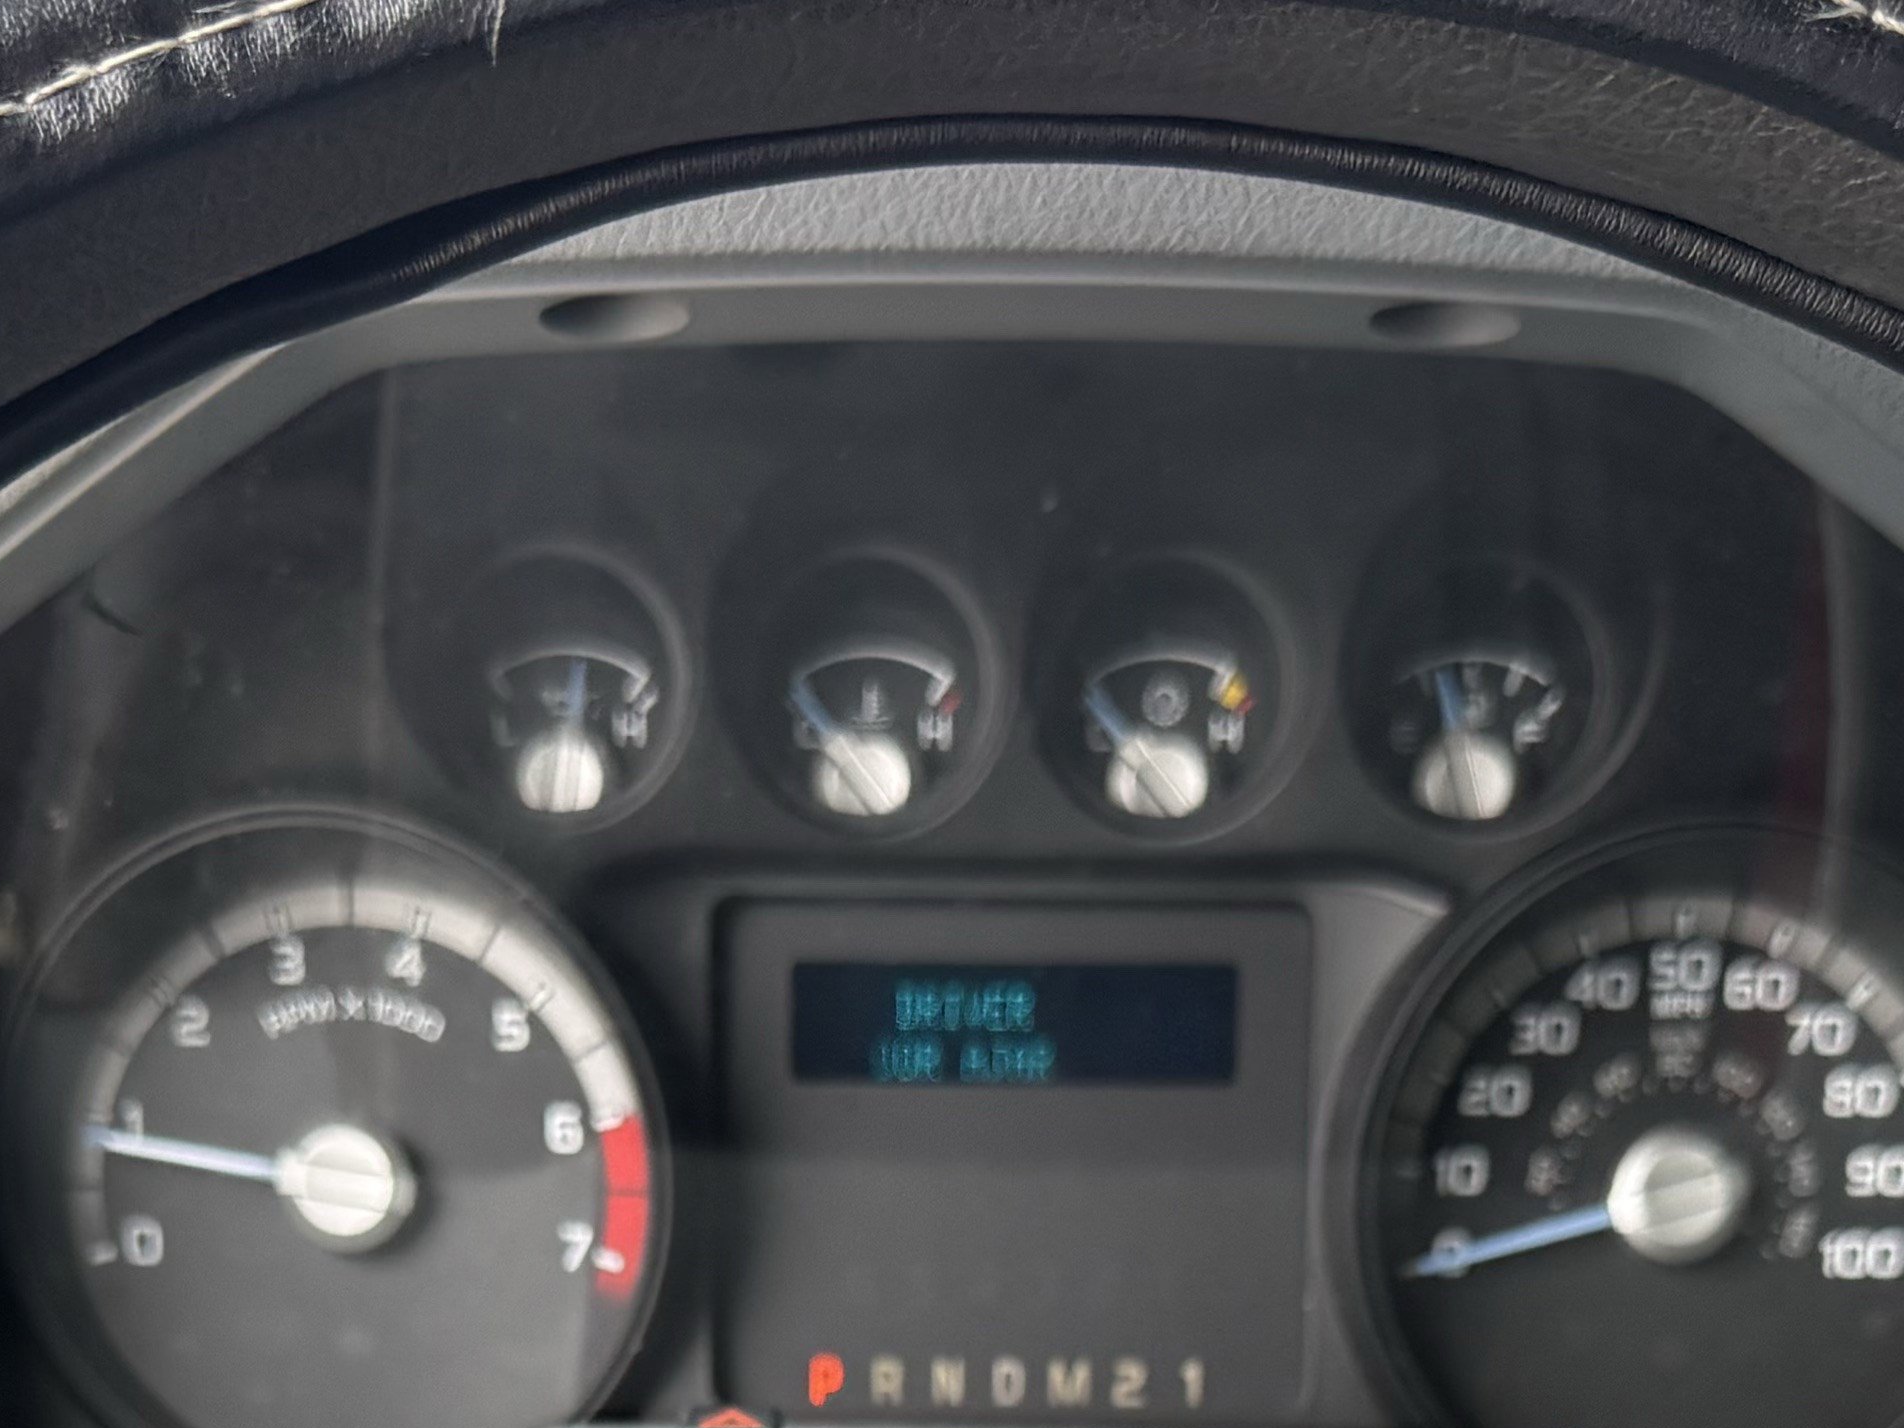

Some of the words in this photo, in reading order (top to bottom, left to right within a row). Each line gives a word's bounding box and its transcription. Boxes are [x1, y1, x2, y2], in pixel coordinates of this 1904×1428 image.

[268, 937, 306, 986] 3
[386, 938, 427, 988] 4
[1566, 955, 1641, 1011] 40
[1648, 940, 1724, 993] 50
[1723, 955, 1800, 1011] 60
[171, 996, 211, 1048] 2
[491, 1001, 532, 1052] 5
[1508, 1003, 1581, 1056] 30
[1785, 1003, 1859, 1057] 70
[1458, 1063, 1533, 1117] 20
[1822, 1063, 1899, 1118] 80
[543, 1101, 585, 1155] 6
[1435, 1143, 1491, 1198] 10
[119, 1214, 164, 1267] 0
[557, 1221, 594, 1273] 7
[808, 1352, 845, 1408] P
[870, 1354, 905, 1407] R
[930, 1355, 965, 1407] N
[1046, 1355, 1092, 1407] M
[1110, 1356, 1149, 1409] 2
[1181, 1356, 1205, 1408] 1
